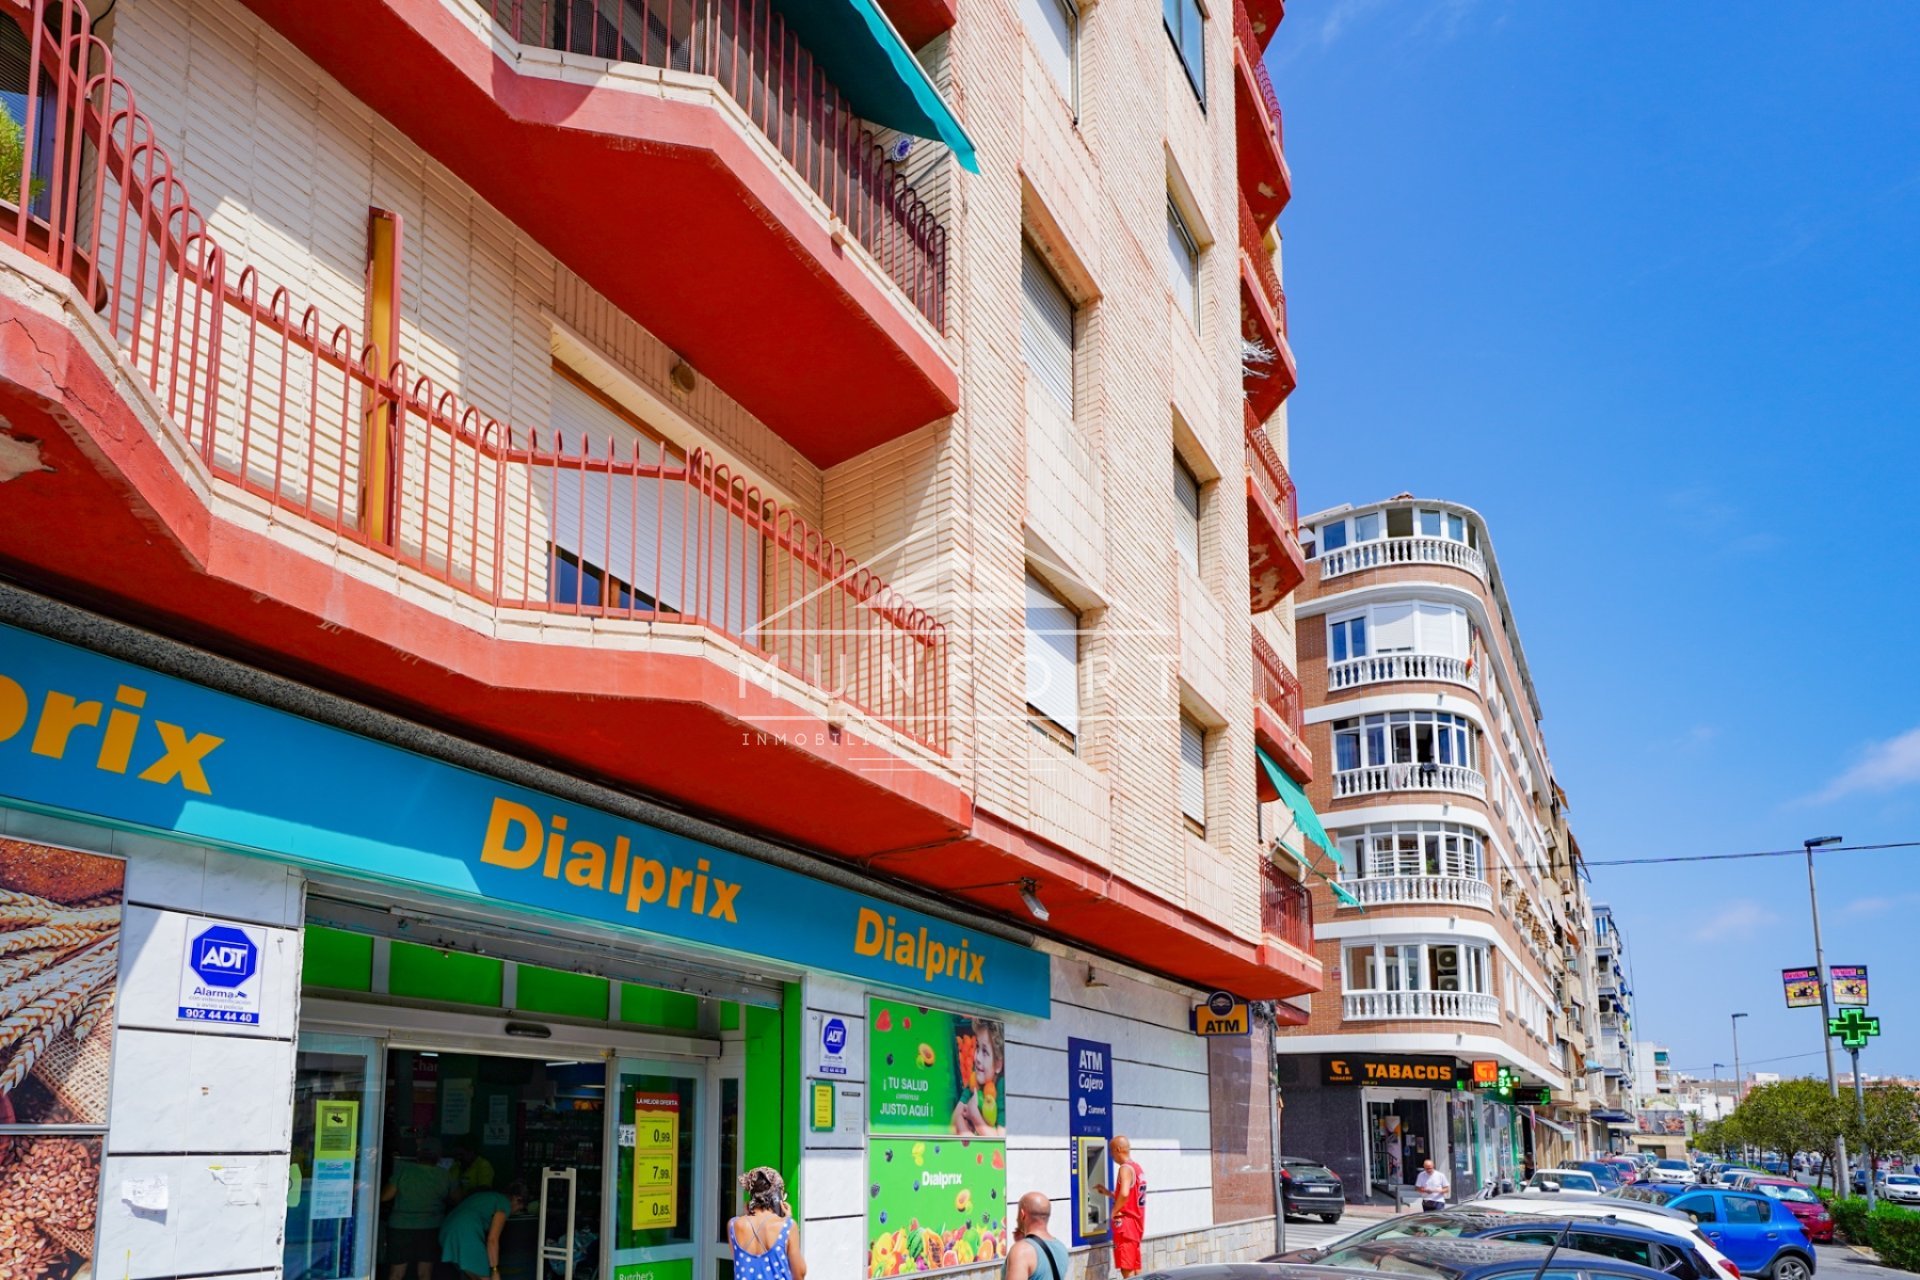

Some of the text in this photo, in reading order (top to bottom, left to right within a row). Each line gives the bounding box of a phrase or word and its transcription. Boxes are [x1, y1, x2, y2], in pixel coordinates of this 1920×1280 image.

[480, 796, 742, 924] Dialprix
[854, 905, 986, 986] Dialprix
[202, 946, 247, 969] ADT
[194, 987, 234, 998] Alarma
[185, 1009, 253, 1023] 902 44 44 40
[1205, 1019, 1240, 1033] ATM
[827, 1030, 844, 1043] ADT
[1079, 1050, 1103, 1071] ATM
[1364, 1063, 1453, 1081] TABACOS
[888, 1077, 900, 1089] TU
[901, 1079, 929, 1091] SALUD
[1078, 1073, 1104, 1092] Cajero
[880, 1103, 908, 1115] JUSTO
[909, 1103, 929, 1117] AQUÍ
[922, 1171, 962, 1189] Dialprix
